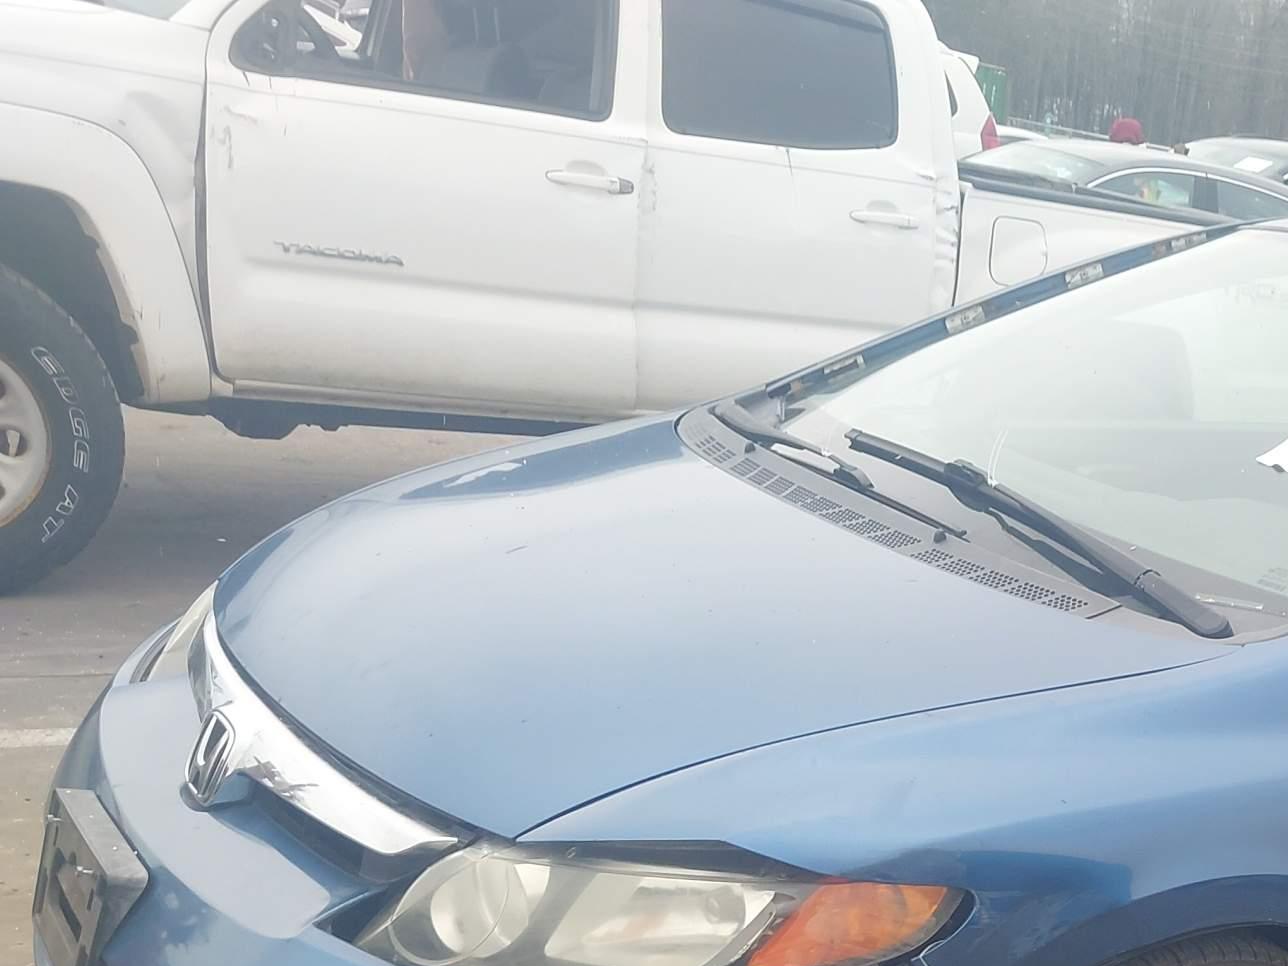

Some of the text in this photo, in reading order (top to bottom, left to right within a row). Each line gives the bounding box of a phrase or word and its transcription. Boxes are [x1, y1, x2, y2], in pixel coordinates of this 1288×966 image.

[273, 241, 404, 266] TACOMA
[30, 345, 91, 543] EDGE AT
